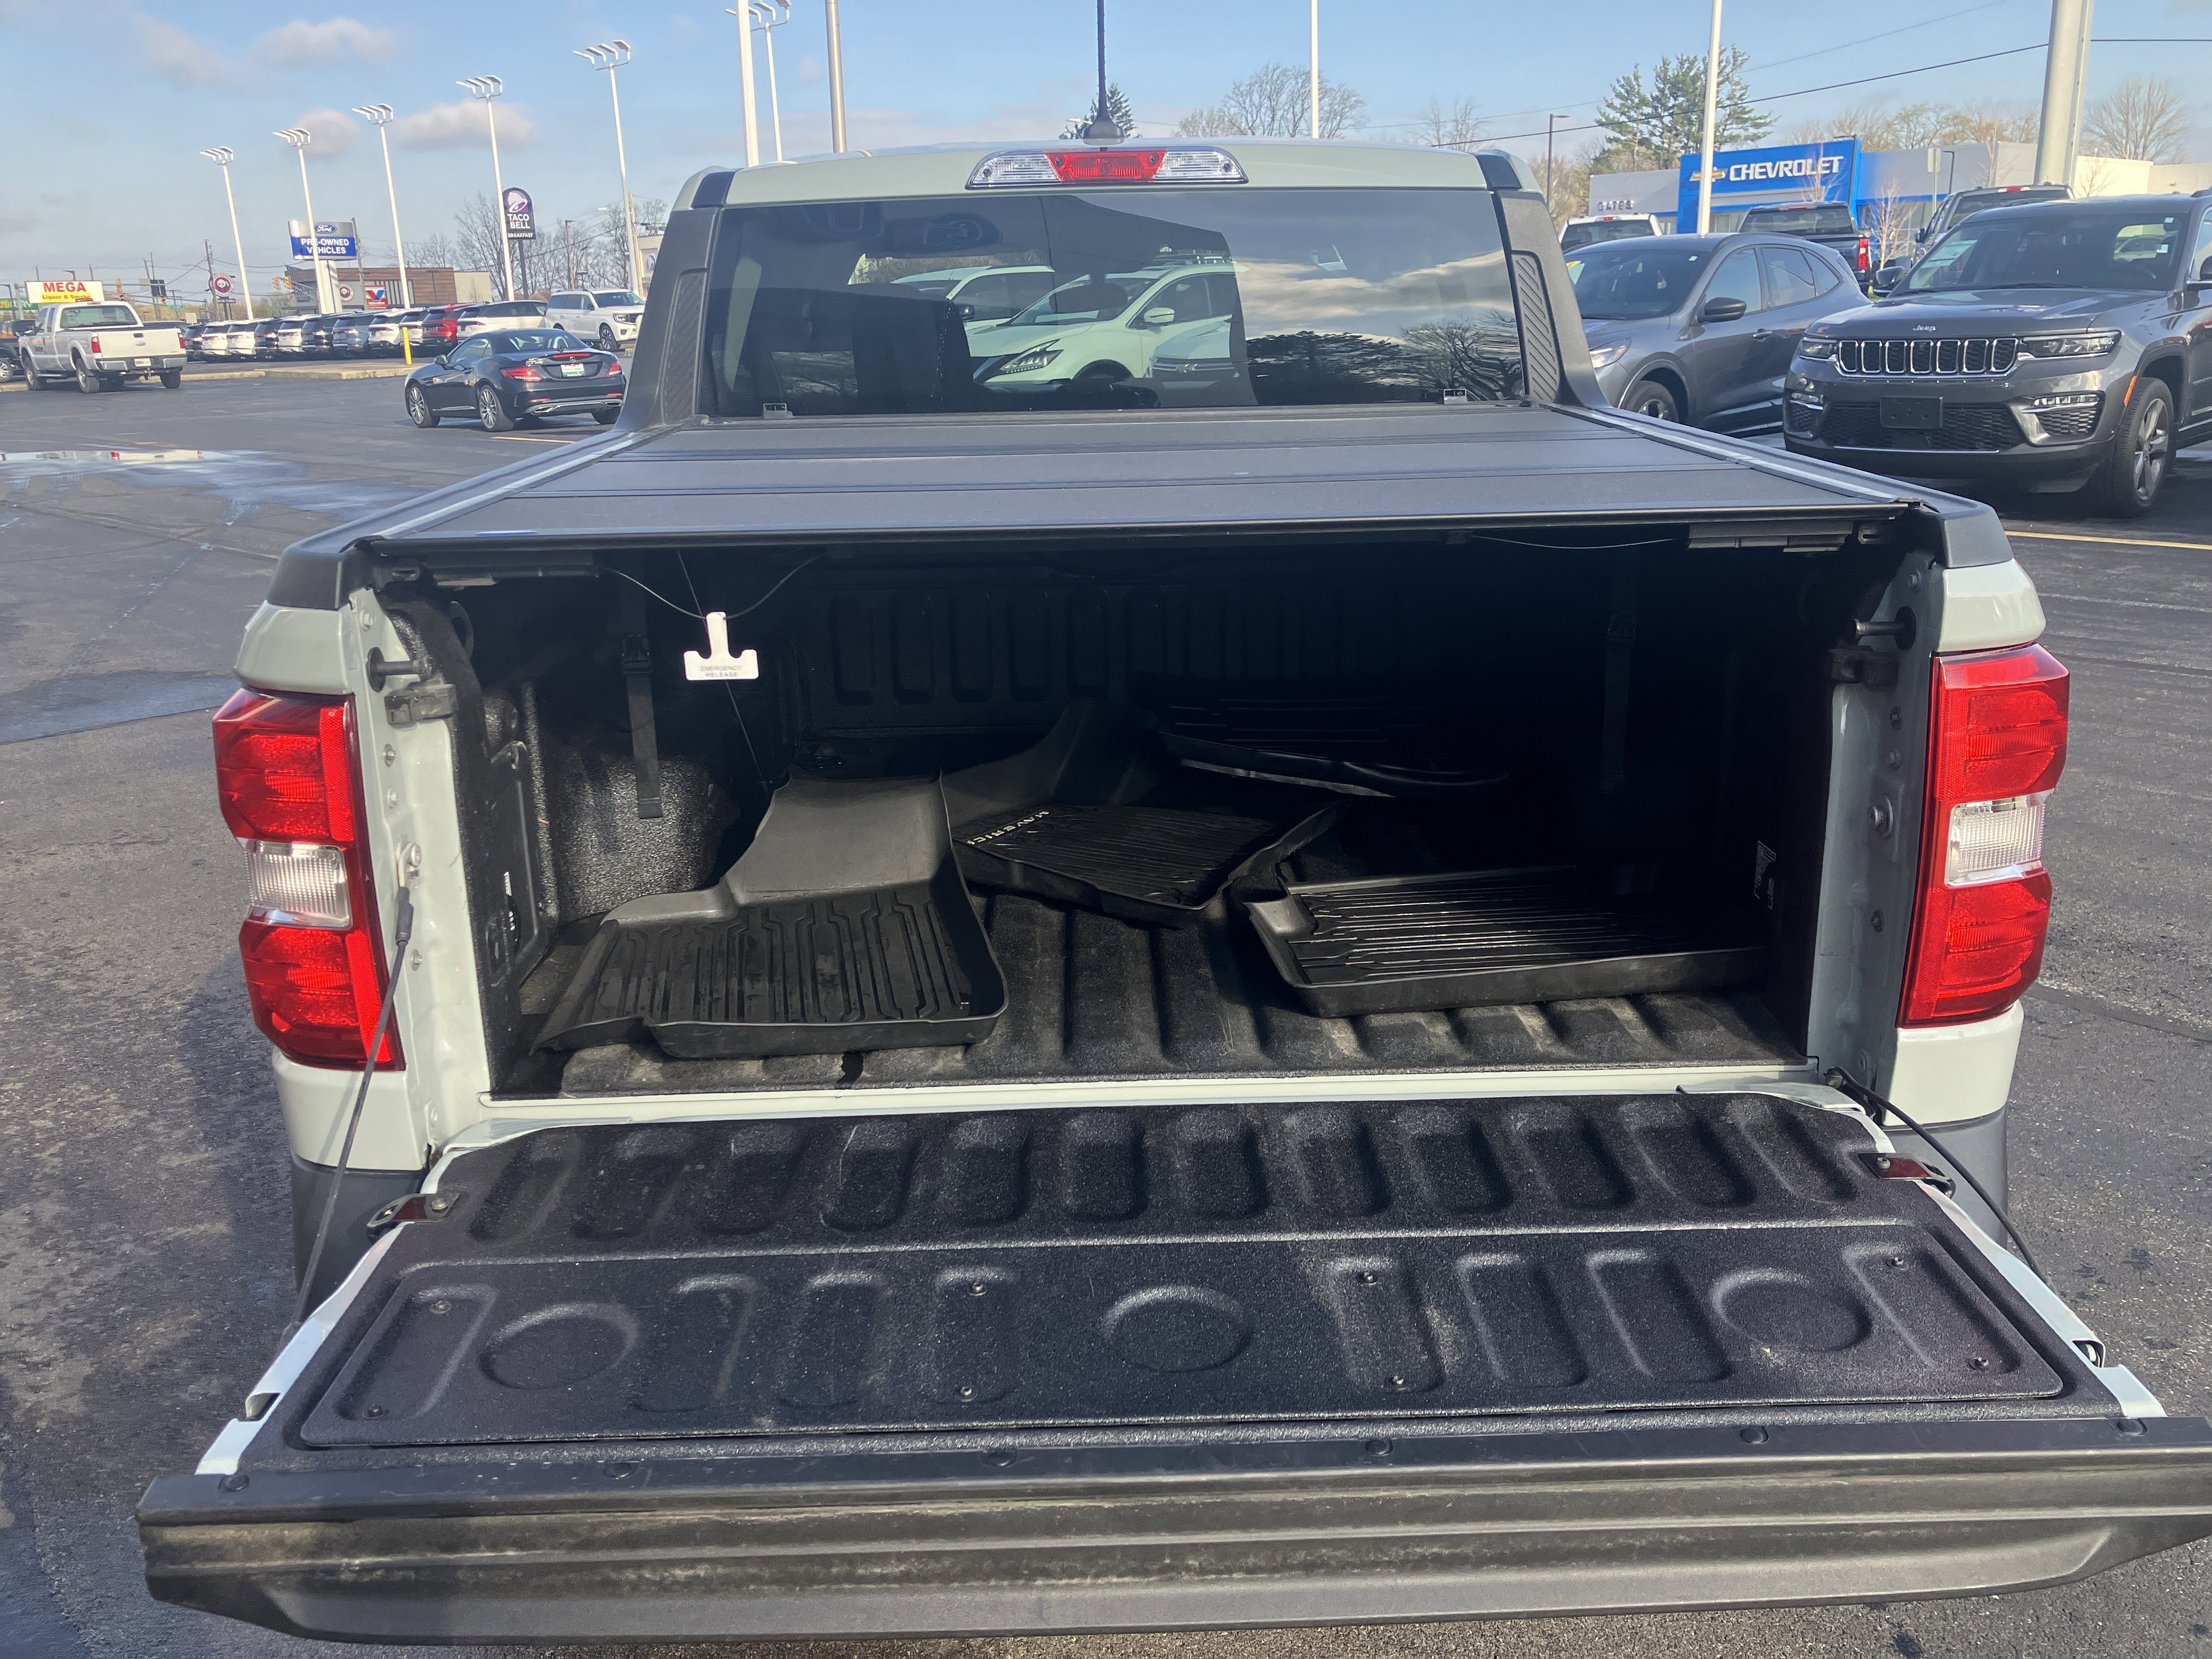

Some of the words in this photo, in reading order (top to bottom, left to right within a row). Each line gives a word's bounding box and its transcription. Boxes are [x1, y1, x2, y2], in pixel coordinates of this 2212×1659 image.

[1729, 155, 1844, 182] CHEVROLET
[1598, 200, 1632, 211] GATES
[507, 213, 530, 222] TACO
[43, 281, 87, 292] MEGA
[1912, 324, 1936, 332] Jeep
